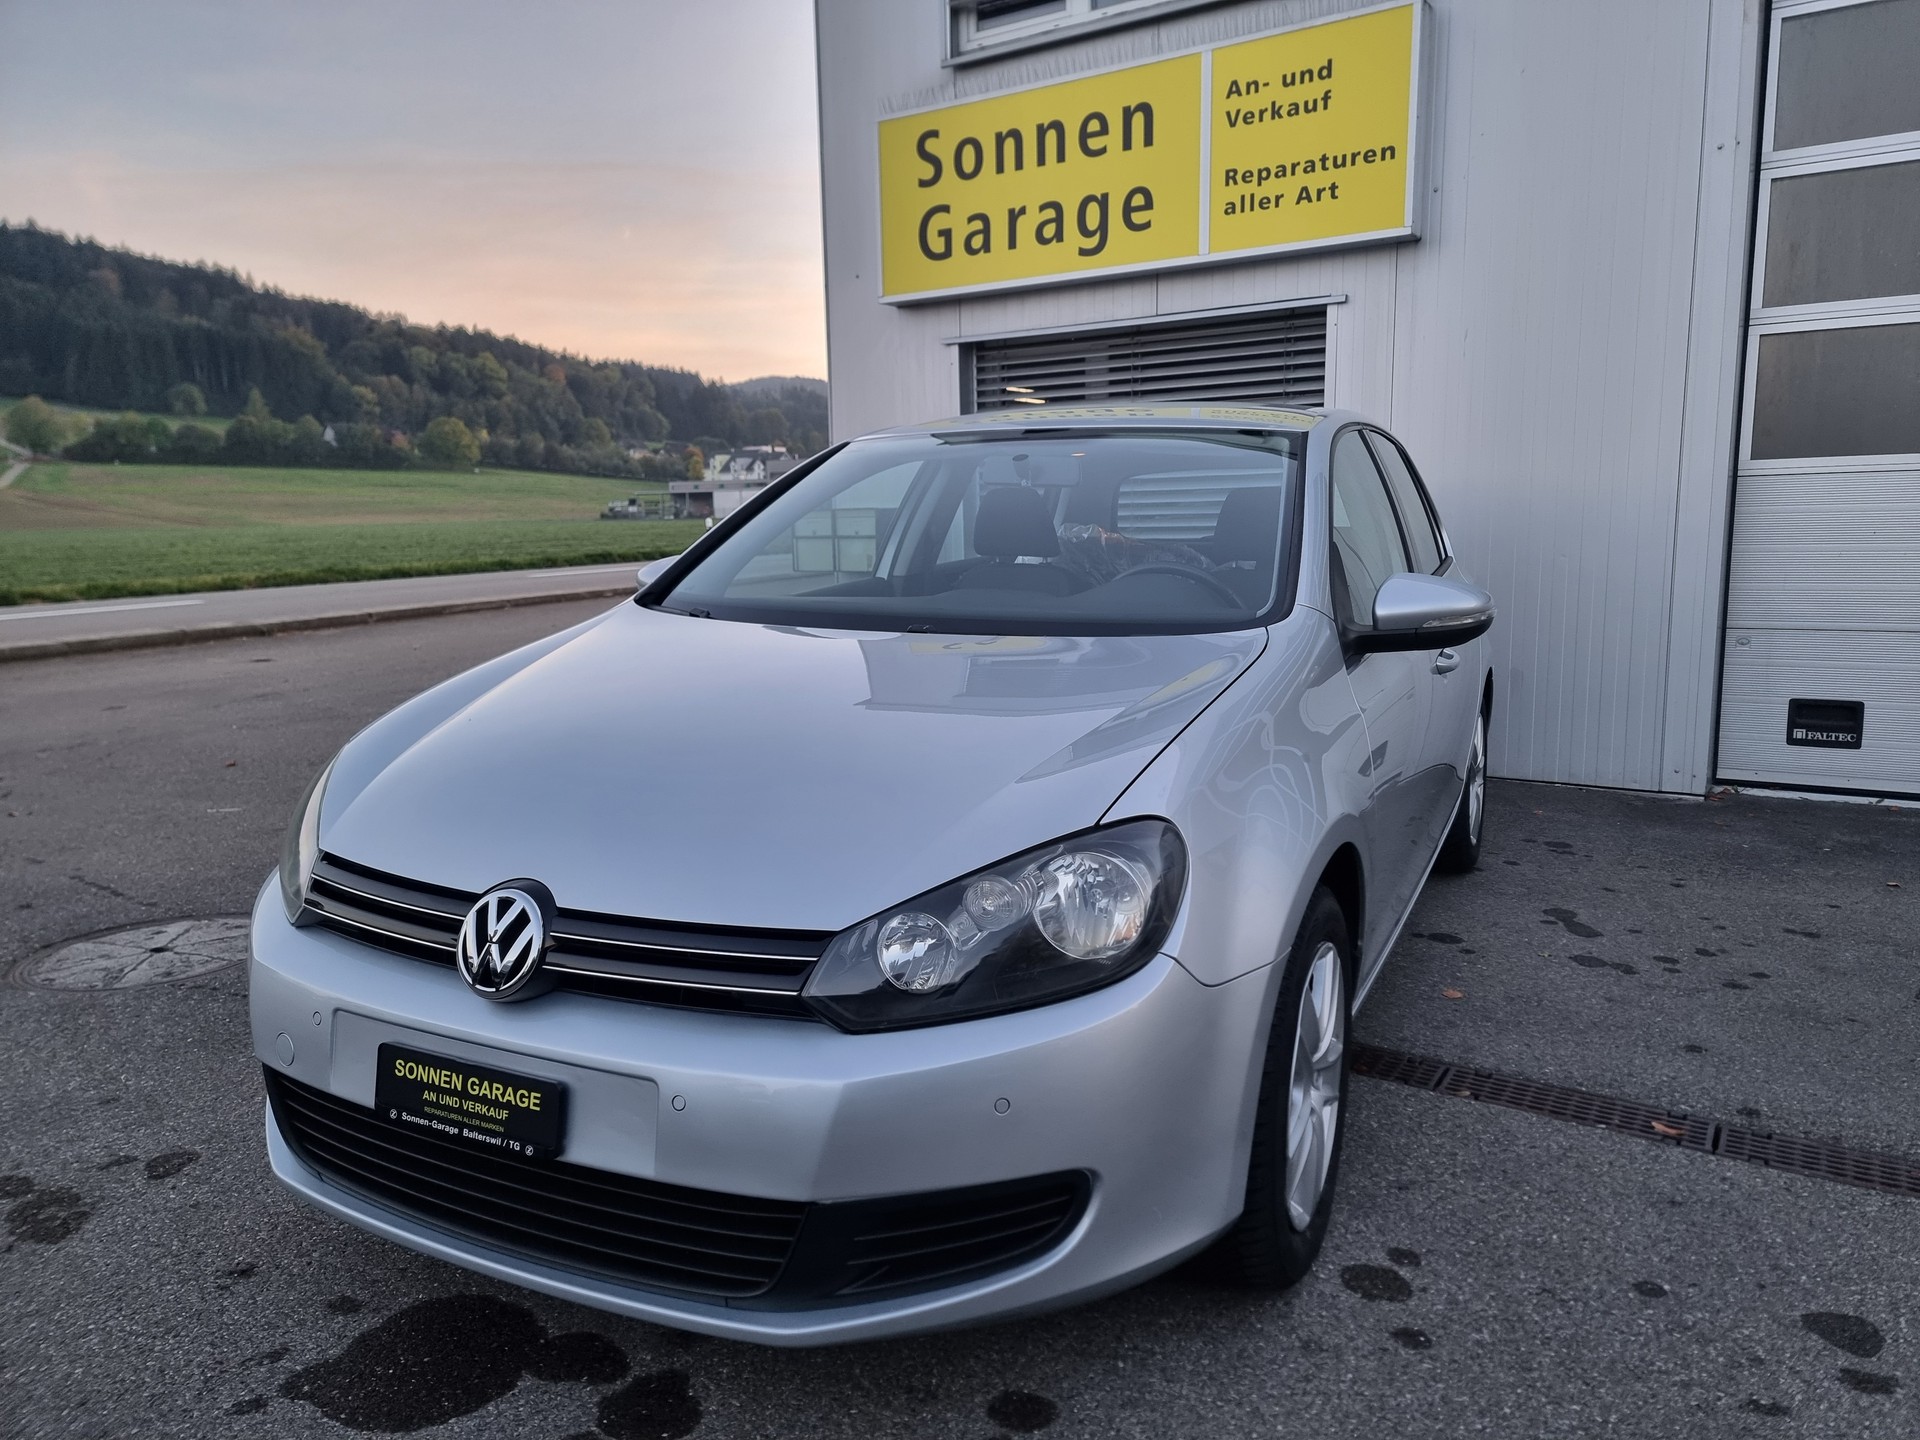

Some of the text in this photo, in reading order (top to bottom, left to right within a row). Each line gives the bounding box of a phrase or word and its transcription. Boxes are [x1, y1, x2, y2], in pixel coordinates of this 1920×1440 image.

[1225, 58, 1334, 99] An- und
[1225, 90, 1333, 129] Verkauf
[915, 100, 1155, 188] Sonnen
[1224, 144, 1397, 187] Reparaturen
[1223, 181, 1340, 216] aller Art
[918, 184, 1155, 261] Garage
[1807, 731, 1857, 742] FALTEC
[394, 1059, 541, 1111] SONNEN GARAGE
[423, 1090, 509, 1121] AN UND VERKAUF
[424, 1106, 463, 1122] REPARATUREN
[463, 1114, 480, 1127] ALLER
[401, 1112, 459, 1135] Sonnen-Garage
[463, 1128, 501, 1146] Balterswil
[509, 1140, 520, 1151] TG
